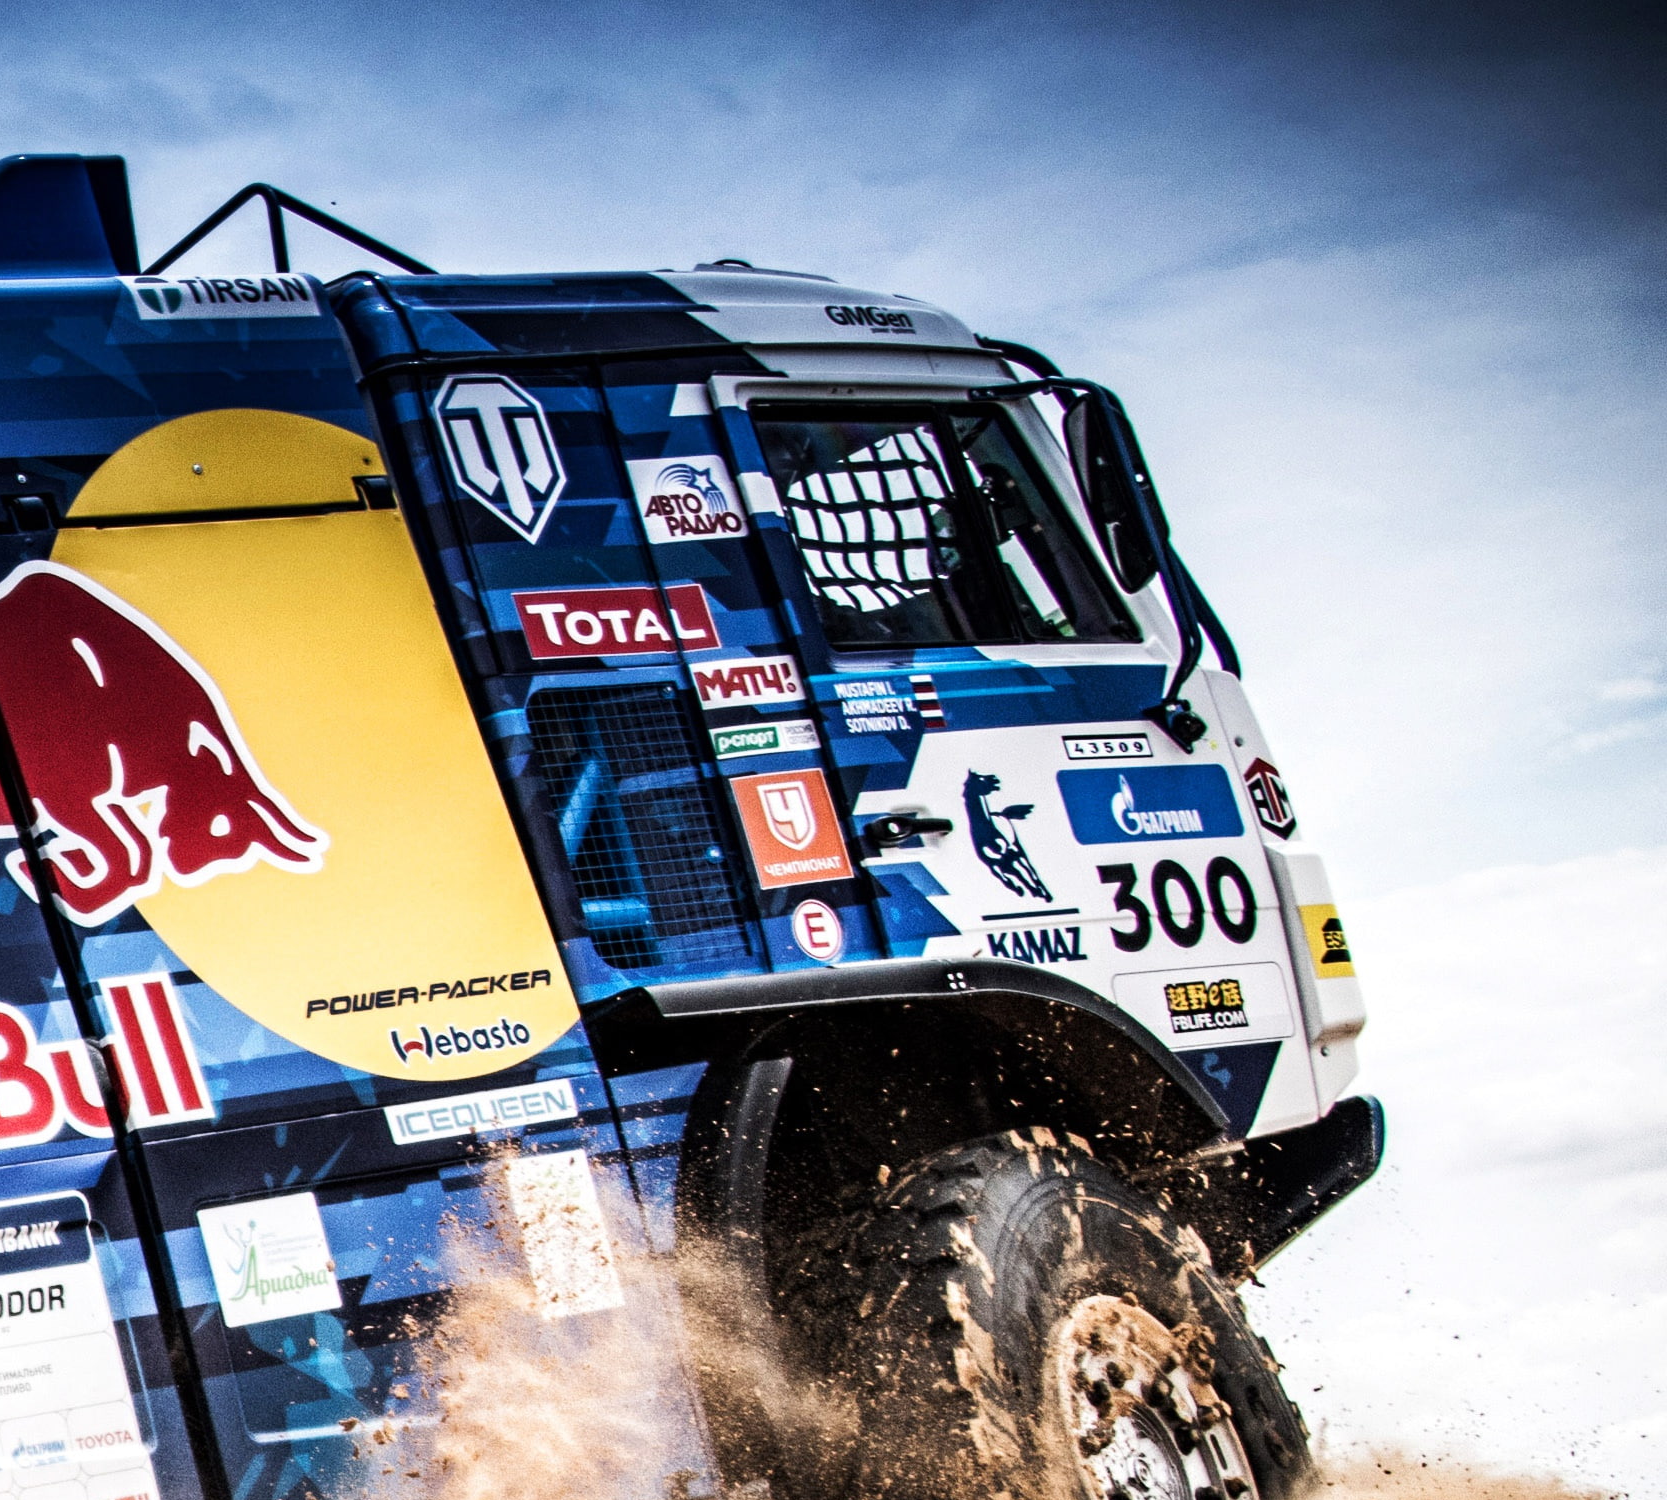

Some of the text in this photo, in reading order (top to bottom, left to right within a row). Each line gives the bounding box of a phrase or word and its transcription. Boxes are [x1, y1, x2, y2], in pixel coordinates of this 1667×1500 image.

[825, 305, 914, 328] GMGen
[645, 493, 702, 518] АВТО
[665, 511, 743, 537] РАДИО
[525, 603, 707, 646] TOTAL
[833, 681, 887, 698] MUSTAFIN
[841, 699, 905, 716] AKHMADEEV
[845, 716, 898, 733] SOTNIKOV
[1074, 741, 1144, 754] 43509
[1140, 808, 1204, 835] GAZPROM
[764, 855, 842, 877] ЧЕМПИОНАТ
[1096, 855, 1258, 953] 300
[987, 926, 1088, 965] KAMAZ
[306, 969, 552, 1019] POWER-PACKER
[1171, 1010, 1247, 1031] FBLIFE.COM
[390, 1018, 531, 1064] Webasto
[395, 1088, 569, 1138] ICEQUEEN
[75, 1430, 134, 1451] TOYOTA
